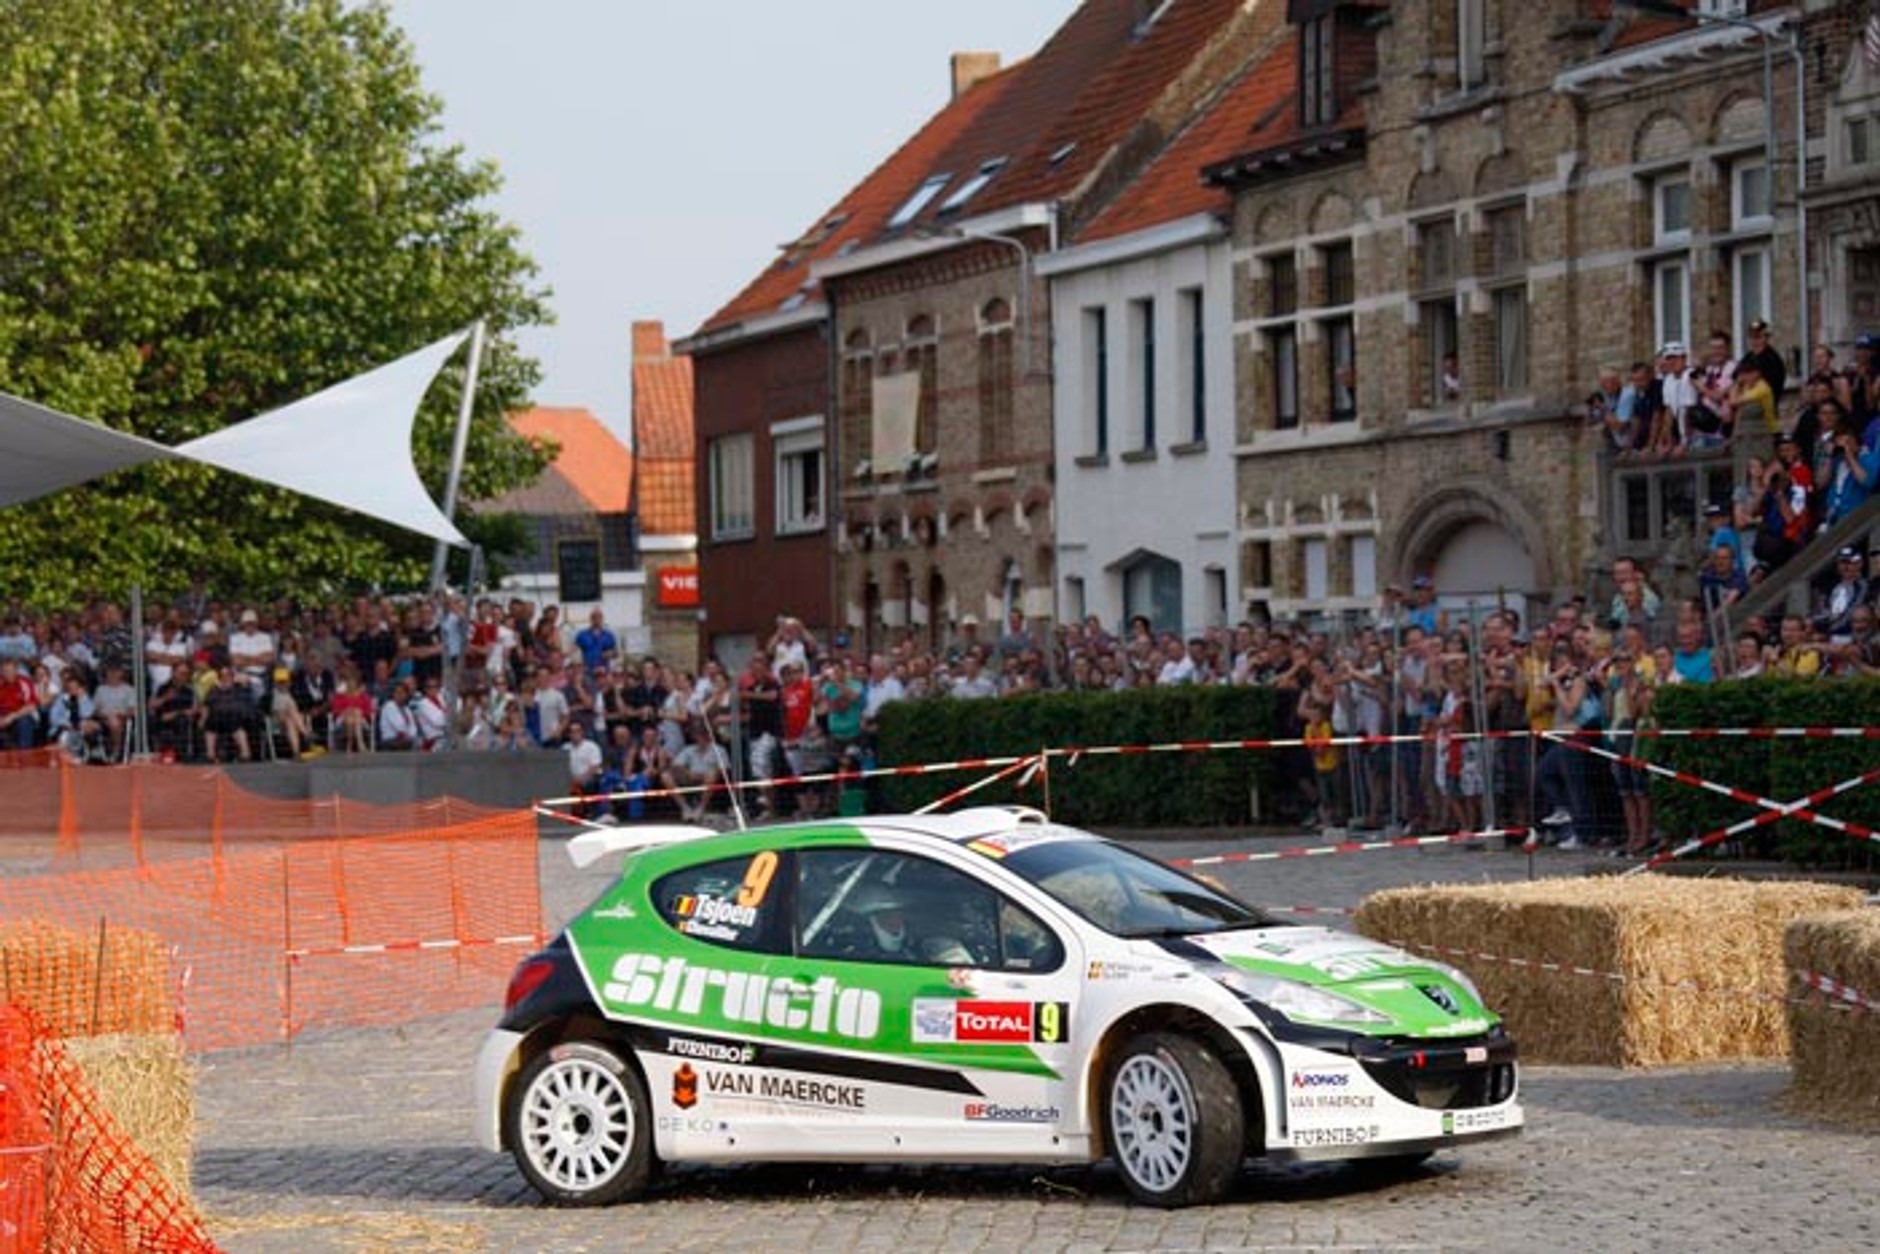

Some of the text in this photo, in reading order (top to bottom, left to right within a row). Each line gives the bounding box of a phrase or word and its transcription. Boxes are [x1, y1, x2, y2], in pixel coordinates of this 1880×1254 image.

[738, 851, 778, 907] 9
[694, 894, 756, 927] Tsjoen
[1039, 1002, 1060, 1042] 9
[706, 1070, 753, 1094] VAN
[760, 1075, 865, 1108] MAERCKE
[964, 1103, 1060, 1119] BFGoodrich
